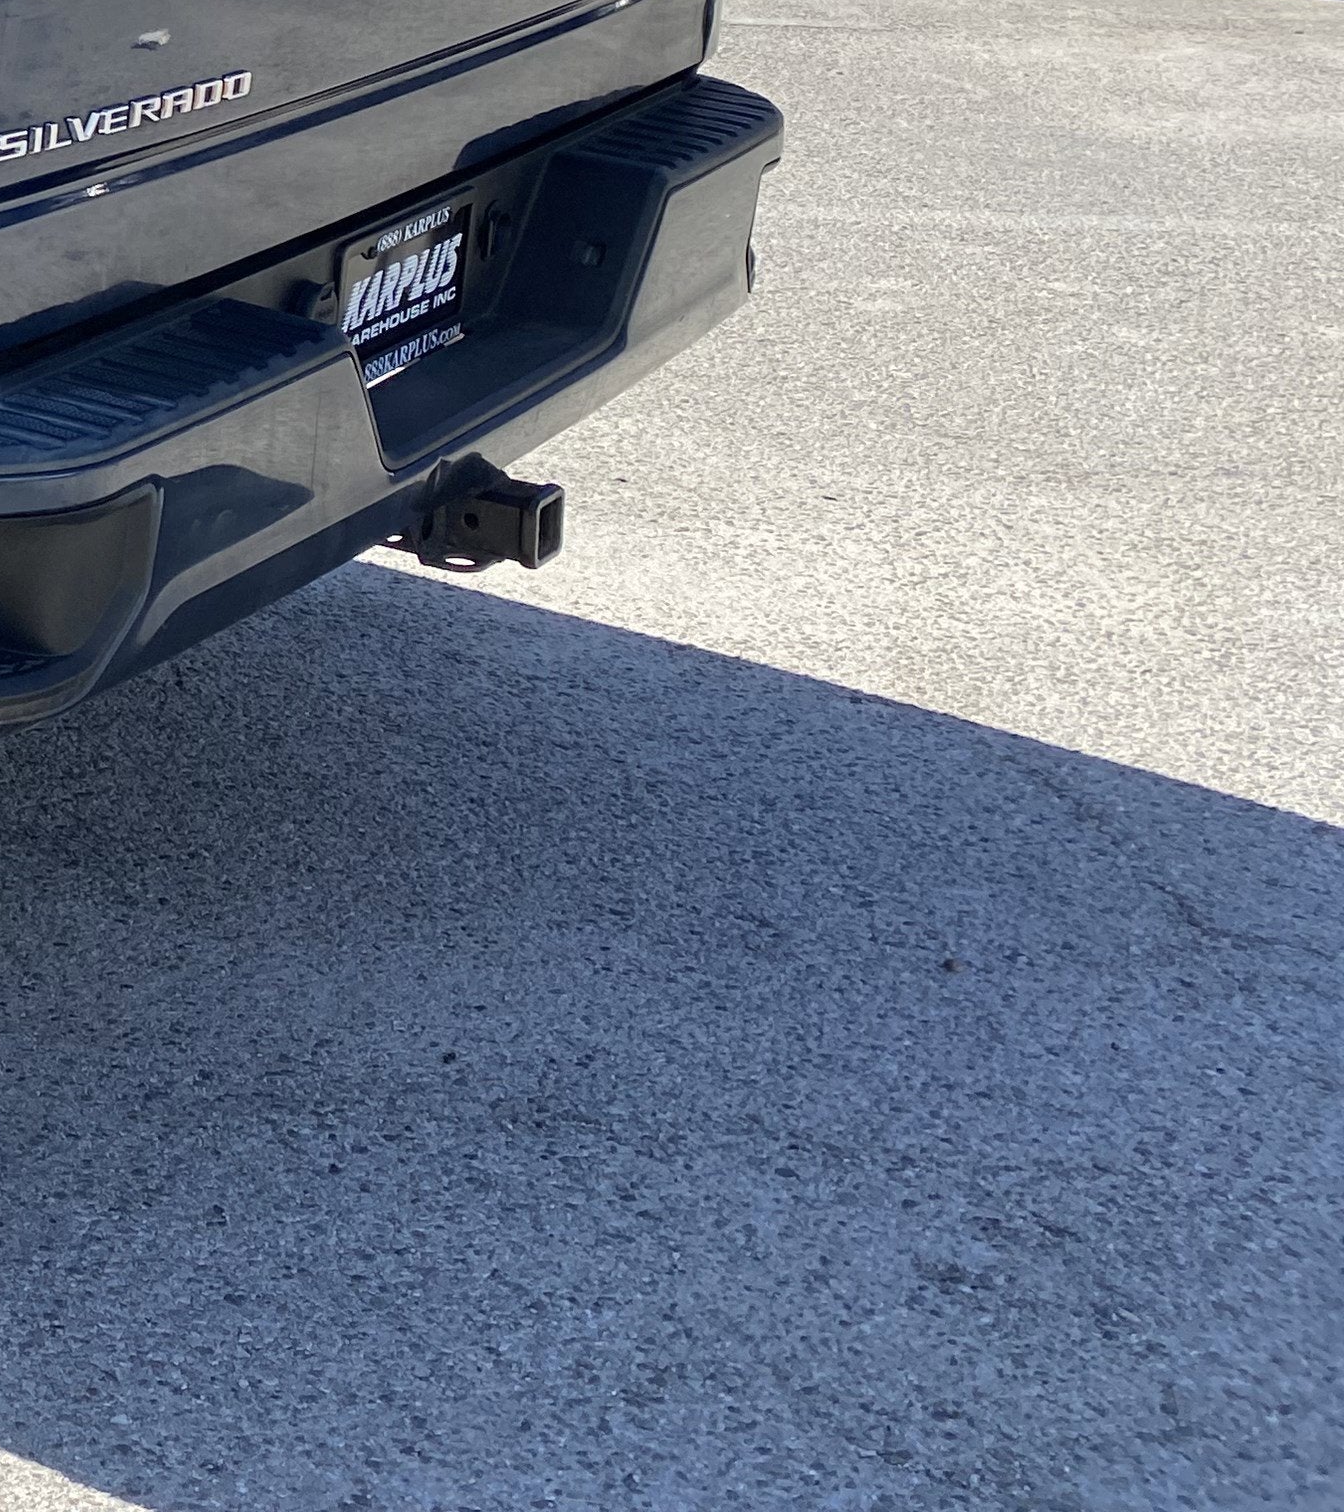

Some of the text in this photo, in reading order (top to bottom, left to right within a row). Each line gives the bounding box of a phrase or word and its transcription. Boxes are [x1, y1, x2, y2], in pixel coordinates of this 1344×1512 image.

[403, 206, 451, 243] KARPLUS
[341, 232, 463, 333] KARPLUS
[350, 286, 457, 346] AREHOUSE INC
